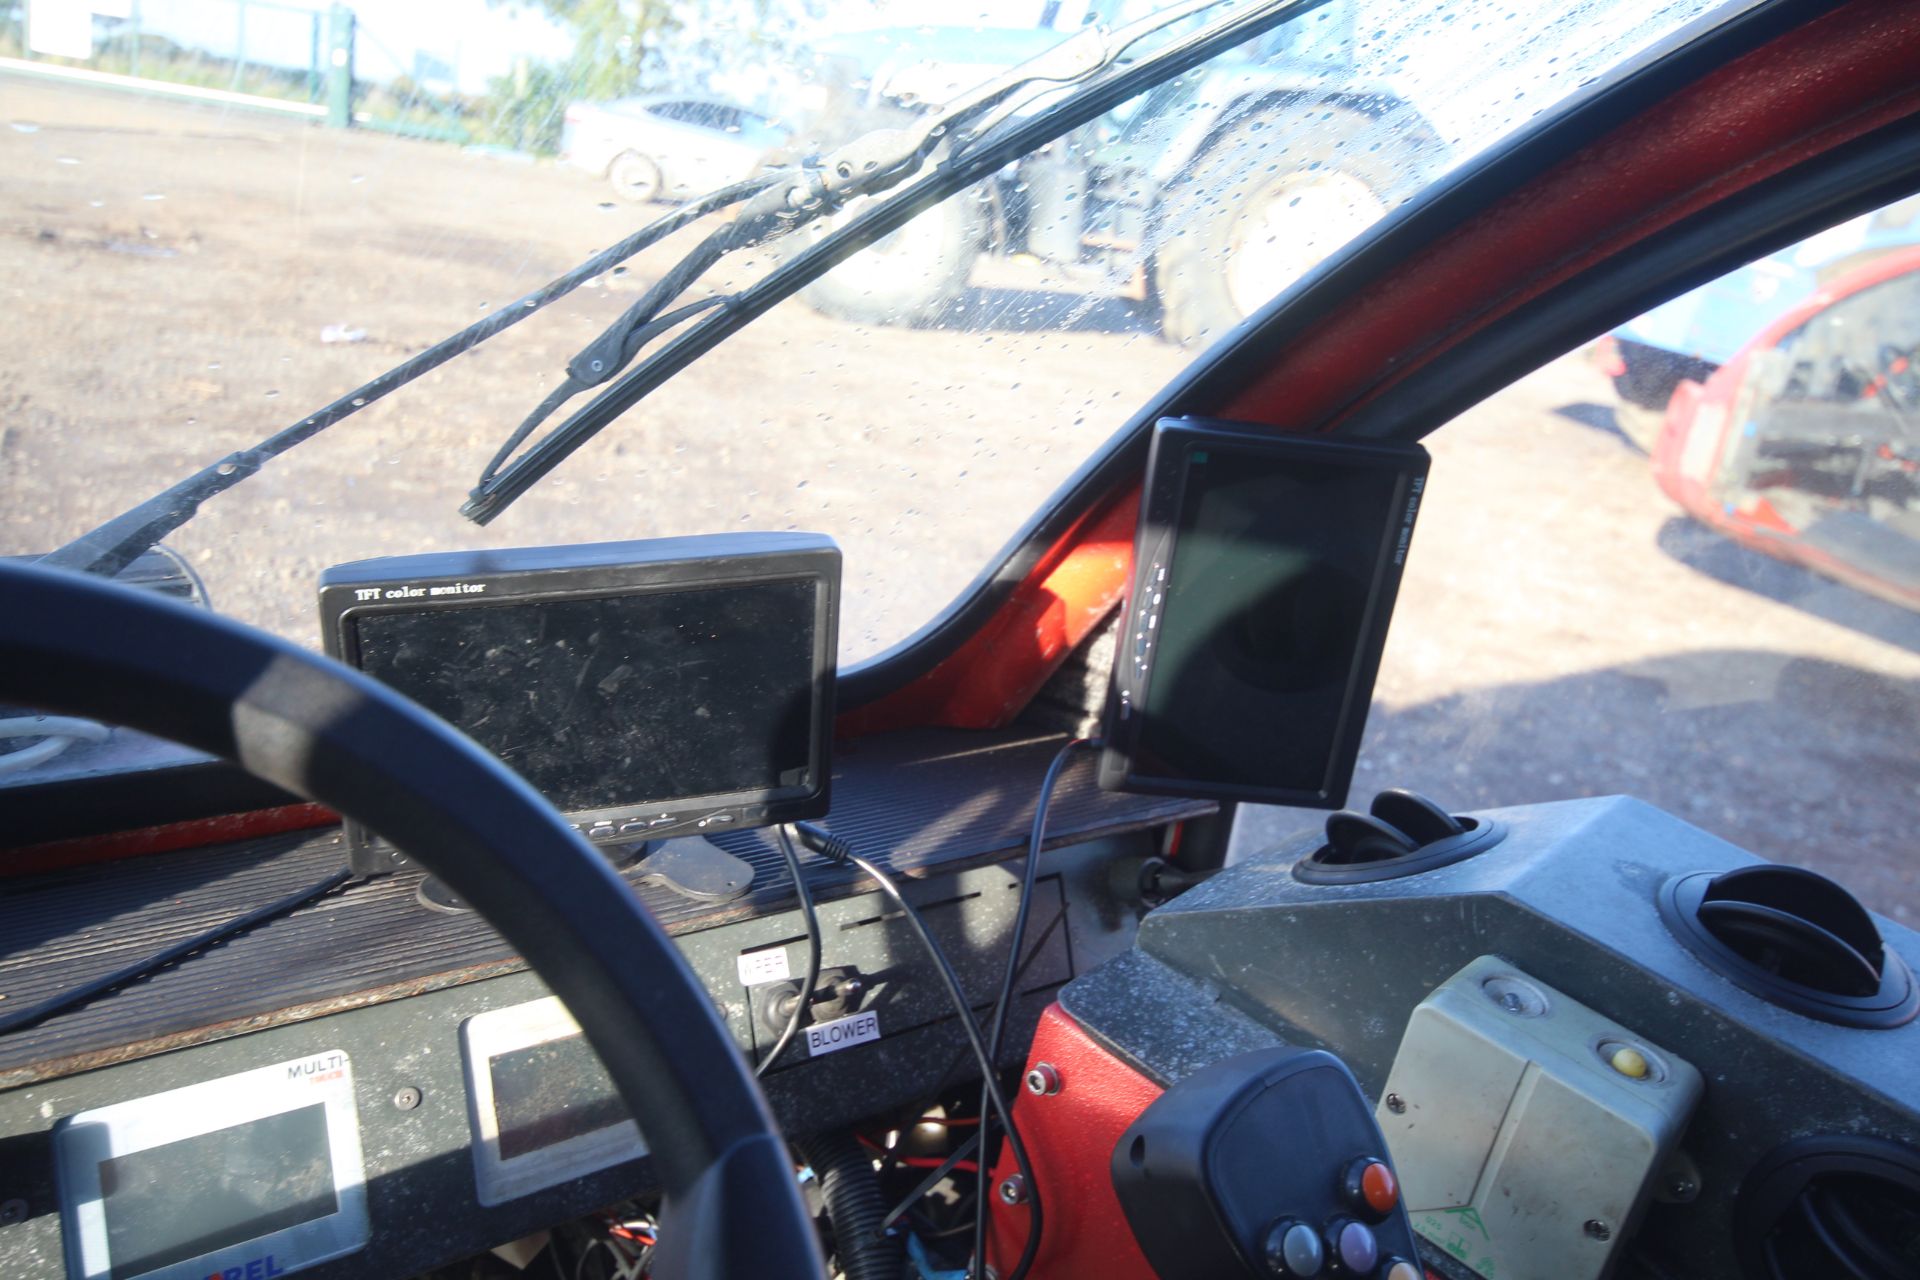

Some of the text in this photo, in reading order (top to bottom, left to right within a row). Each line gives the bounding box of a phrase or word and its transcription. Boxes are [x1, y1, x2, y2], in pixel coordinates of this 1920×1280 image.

[354, 583, 486, 601] TFT color monitor
[810, 1017, 876, 1049] BLOWER
